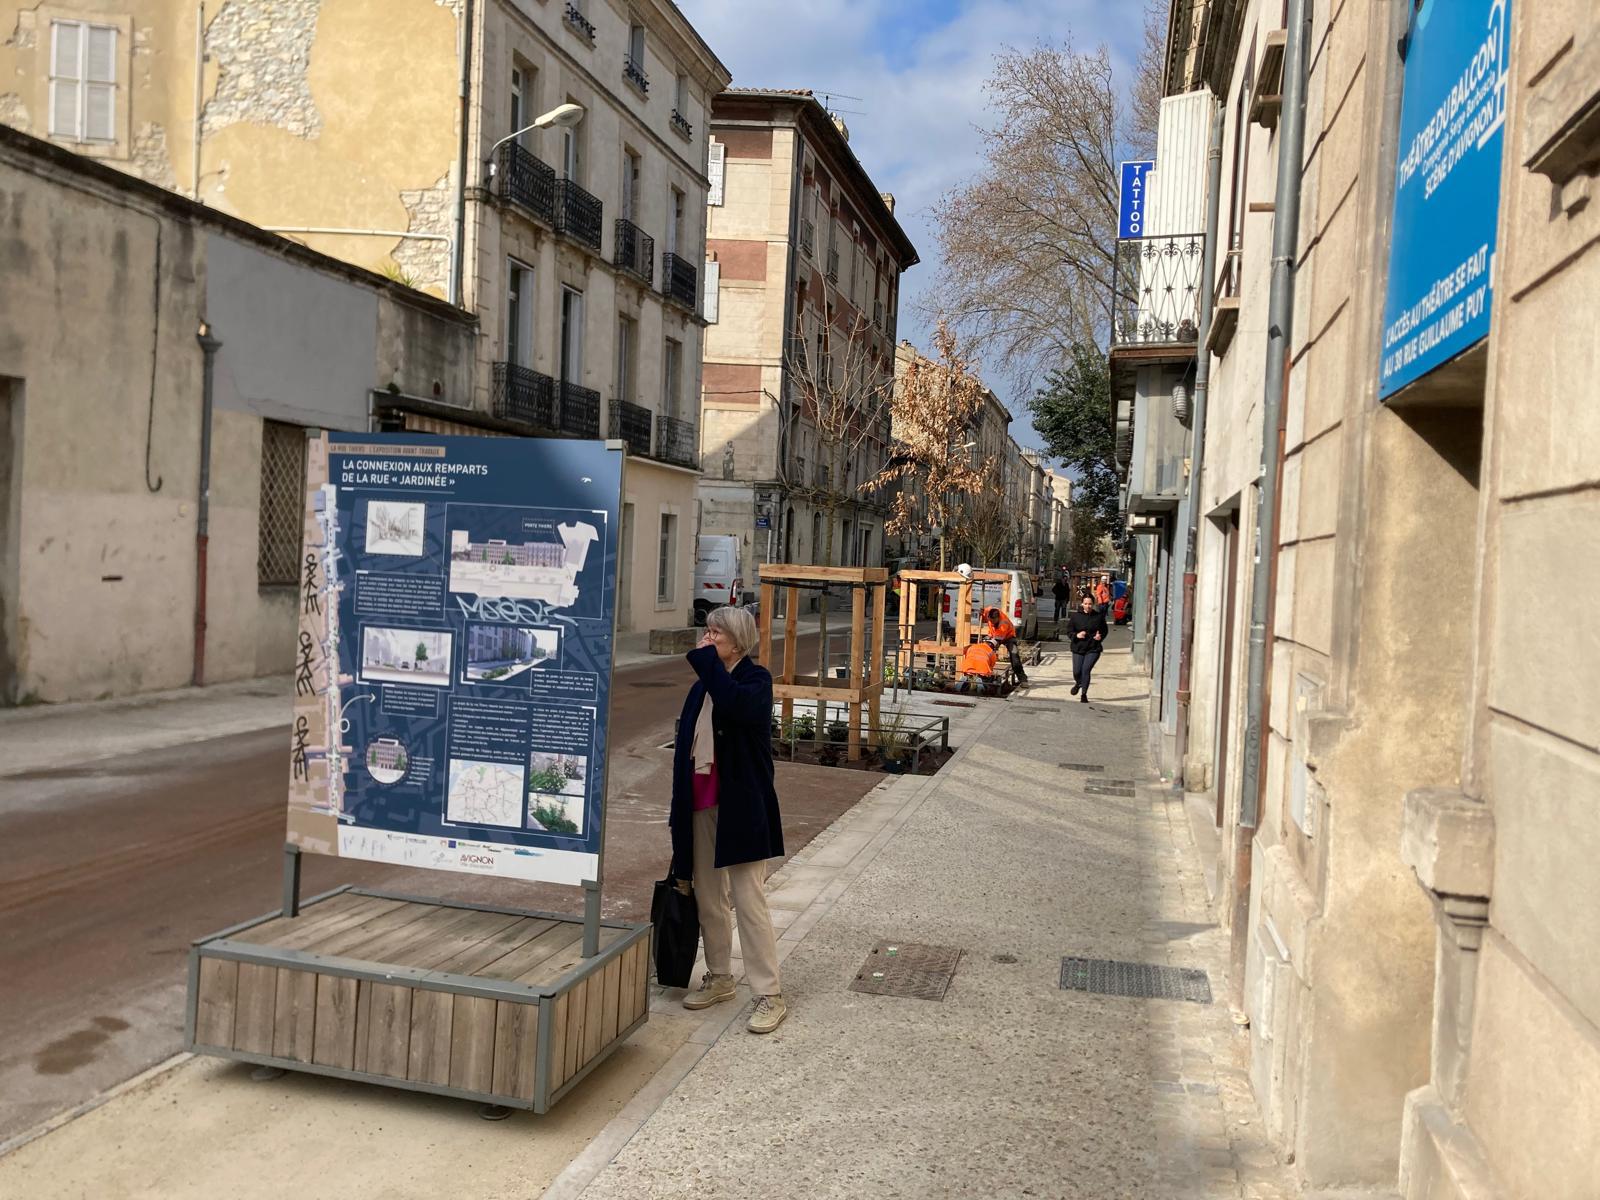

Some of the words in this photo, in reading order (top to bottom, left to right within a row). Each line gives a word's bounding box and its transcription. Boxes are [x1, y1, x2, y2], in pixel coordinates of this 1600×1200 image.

[1400, 116, 1436, 189] THÉÂTRE
[1435, 95, 1451, 141] DU
[1450, 26, 1498, 121] BALCON
[1424, 155, 1448, 200] SCÈNE
[1448, 95, 1495, 174] D'AVIGNON
[1130, 165, 1142, 233] TATTOO
[1409, 303, 1421, 331] AU
[1421, 279, 1454, 321] THÉÂTRE
[1455, 262, 1467, 294] SE
[1467, 243, 1489, 284] FAIT
[1383, 356, 1394, 379] AU
[1403, 337, 1418, 366] RUE
[1418, 301, 1464, 356] GUILLAUME
[1466, 284, 1487, 323] PUY
[342, 459, 355, 470] LA
[356, 460, 412, 473] CONNEXION
[413, 462, 433, 474] AUX
[435, 463, 488, 476] REMPARTS
[342, 472, 354, 483] DE
[356, 473, 369, 484] LA
[370, 474, 390, 485] RUE
[399, 473, 447, 487] JARDINÉE
[460, 854, 494, 865] AVIGNON
